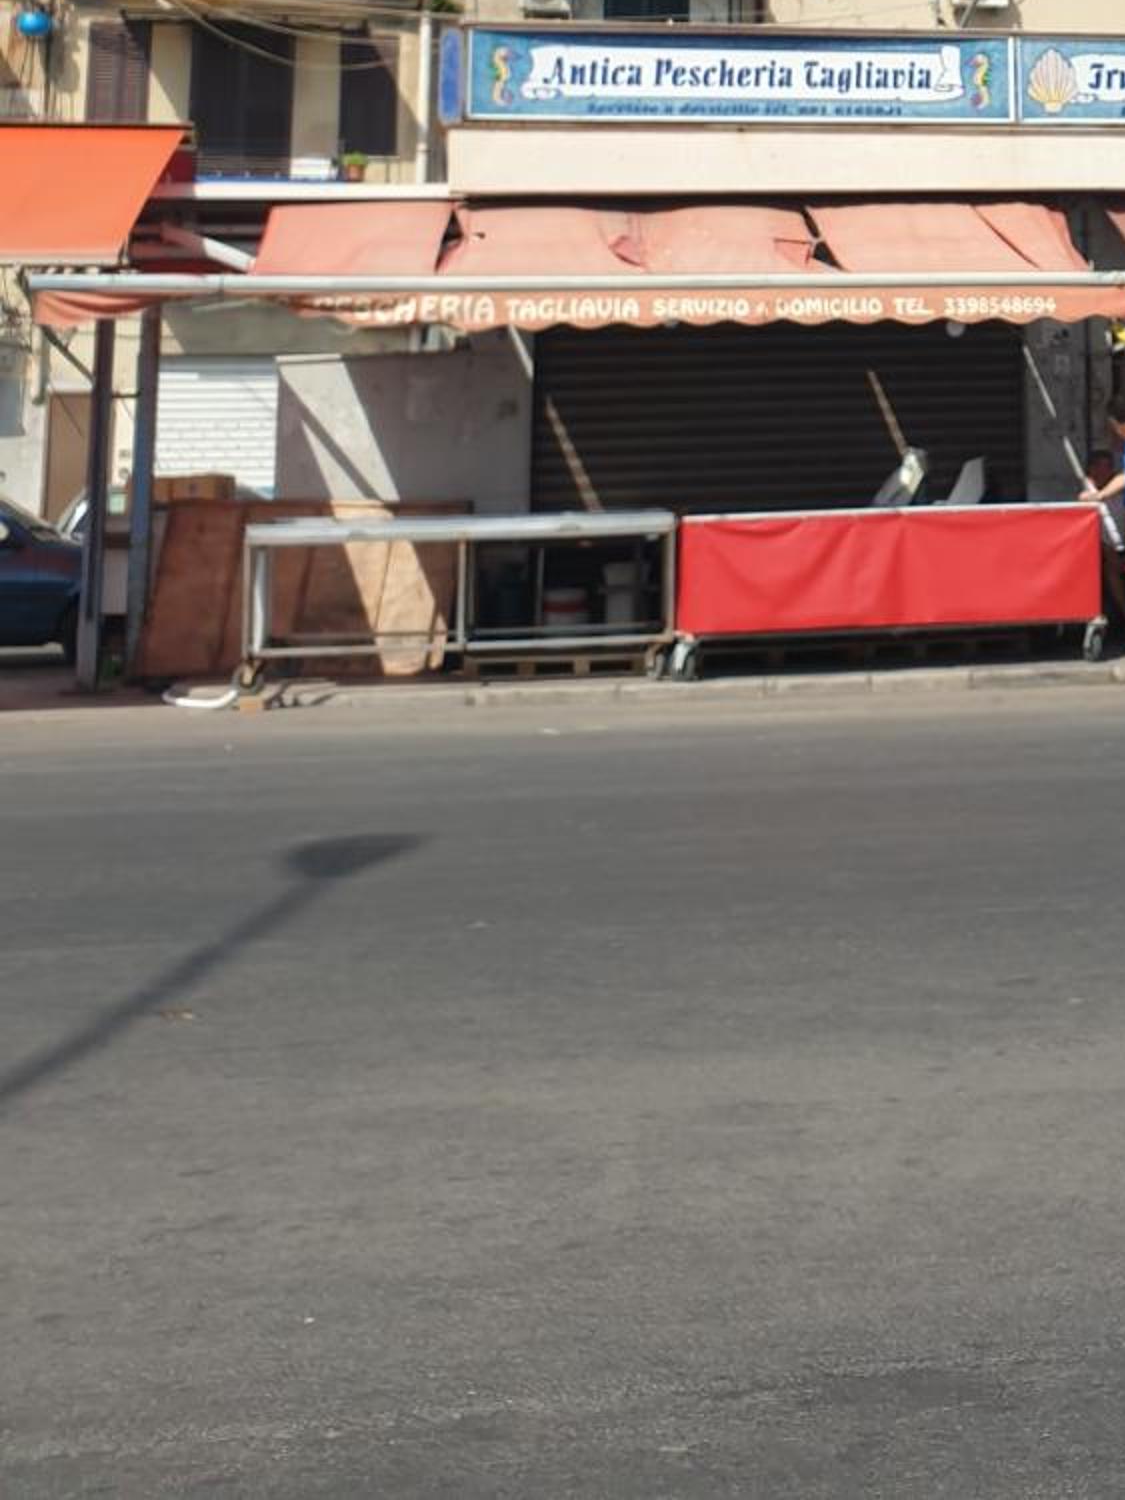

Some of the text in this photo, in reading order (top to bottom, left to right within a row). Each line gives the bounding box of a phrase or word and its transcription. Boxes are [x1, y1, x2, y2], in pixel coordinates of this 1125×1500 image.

[543, 56, 932, 94] Antica Pescheria Tagliavia
[507, 298, 640, 322] TAGLIAVIA
[653, 297, 750, 317] SERVIZIO
[776, 297, 883, 317] DOMICILIO
